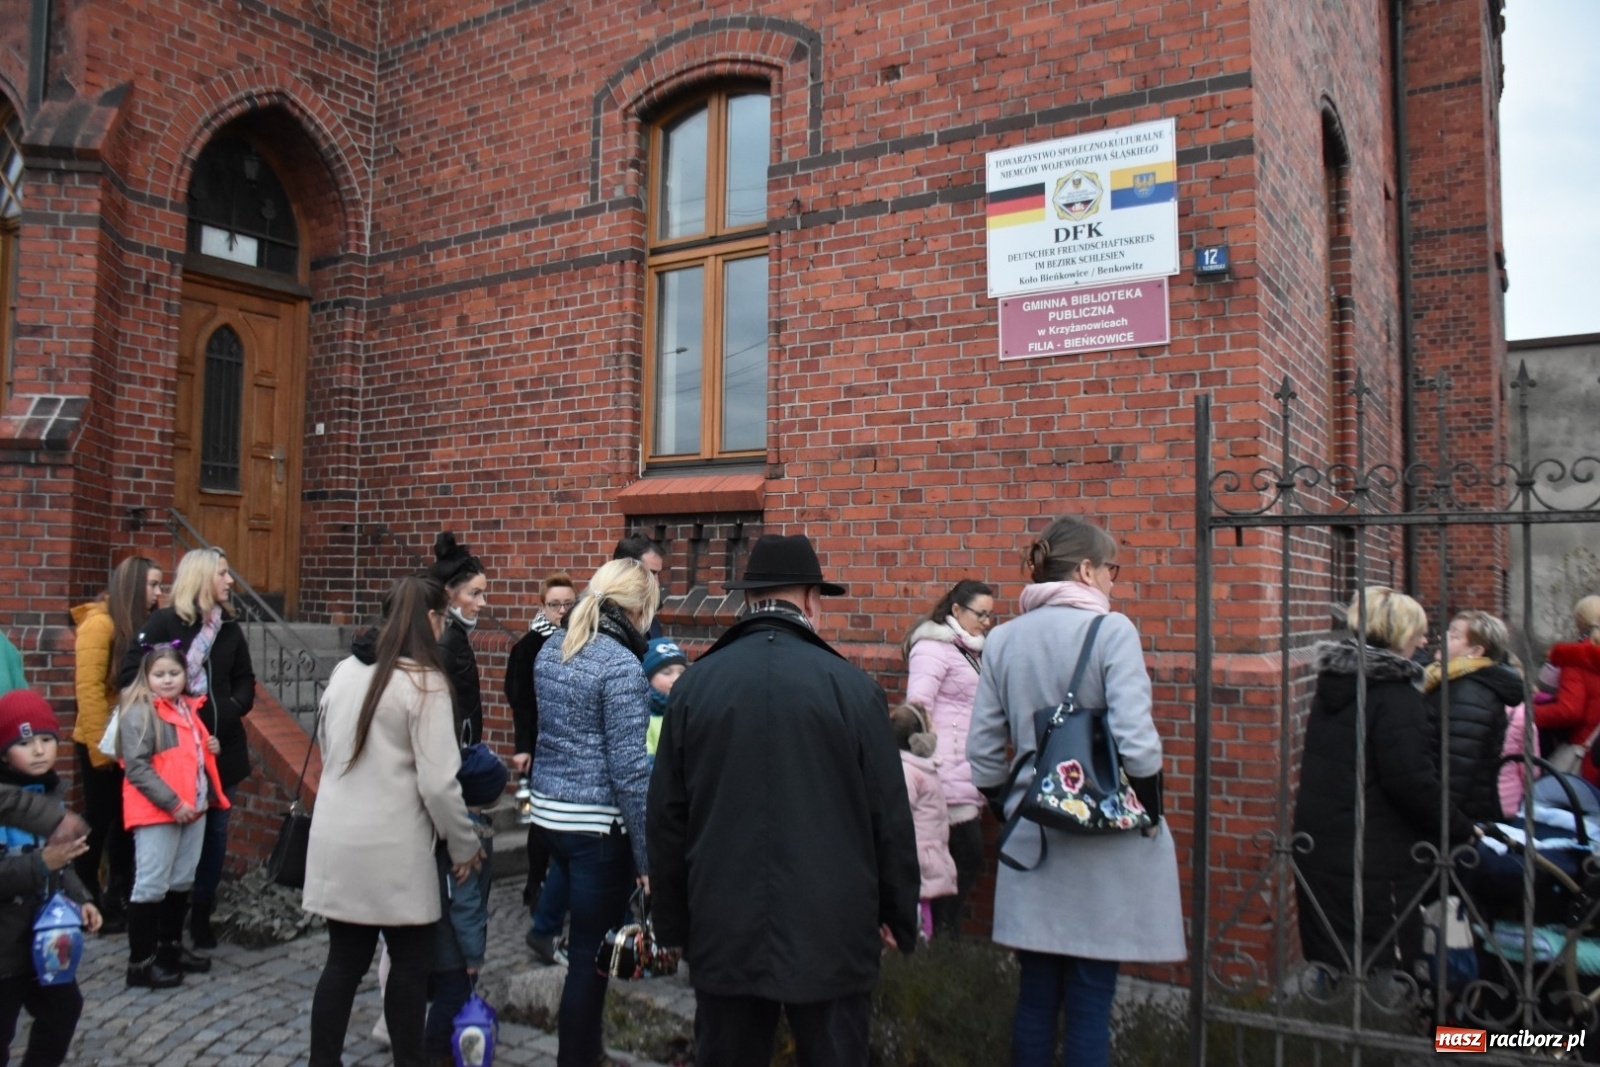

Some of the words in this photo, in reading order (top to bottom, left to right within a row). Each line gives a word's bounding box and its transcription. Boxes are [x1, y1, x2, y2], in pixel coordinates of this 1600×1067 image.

[995, 151, 1056, 168] TOWARZYSTWO
[1000, 164, 1039, 179] NIEMCÓW
[1041, 153, 1108, 171] WOJEWÓDZTWA
[1110, 144, 1159, 160] ŚLĄSKIEGO
[1054, 222, 1103, 243] DFK
[1007, 248, 1056, 262] DEUTSCHER
[1057, 234, 1155, 255] FREUNDSCHAFTSKREIS
[1204, 248, 1218, 265] 12
[1035, 261, 1045, 270] IM
[1047, 257, 1077, 269] BEZIRK
[1079, 250, 1125, 264] SCHLESIEN
[1019, 275, 1038, 285] Koło
[1040, 269, 1089, 282] Bieńkowice
[1097, 262, 1144, 275] Benkowitz
[1022, 297, 1068, 312] GMINNA
[1071, 288, 1143, 306] BIBLIOTEKA
[1048, 304, 1115, 321] PUBLICZNA
[1037, 328, 1046, 336] w
[1049, 317, 1128, 336] Krzyżanowicach
[1028, 341, 1054, 352] FILIA
[1064, 332, 1134, 349] BIEŃKOWICE
